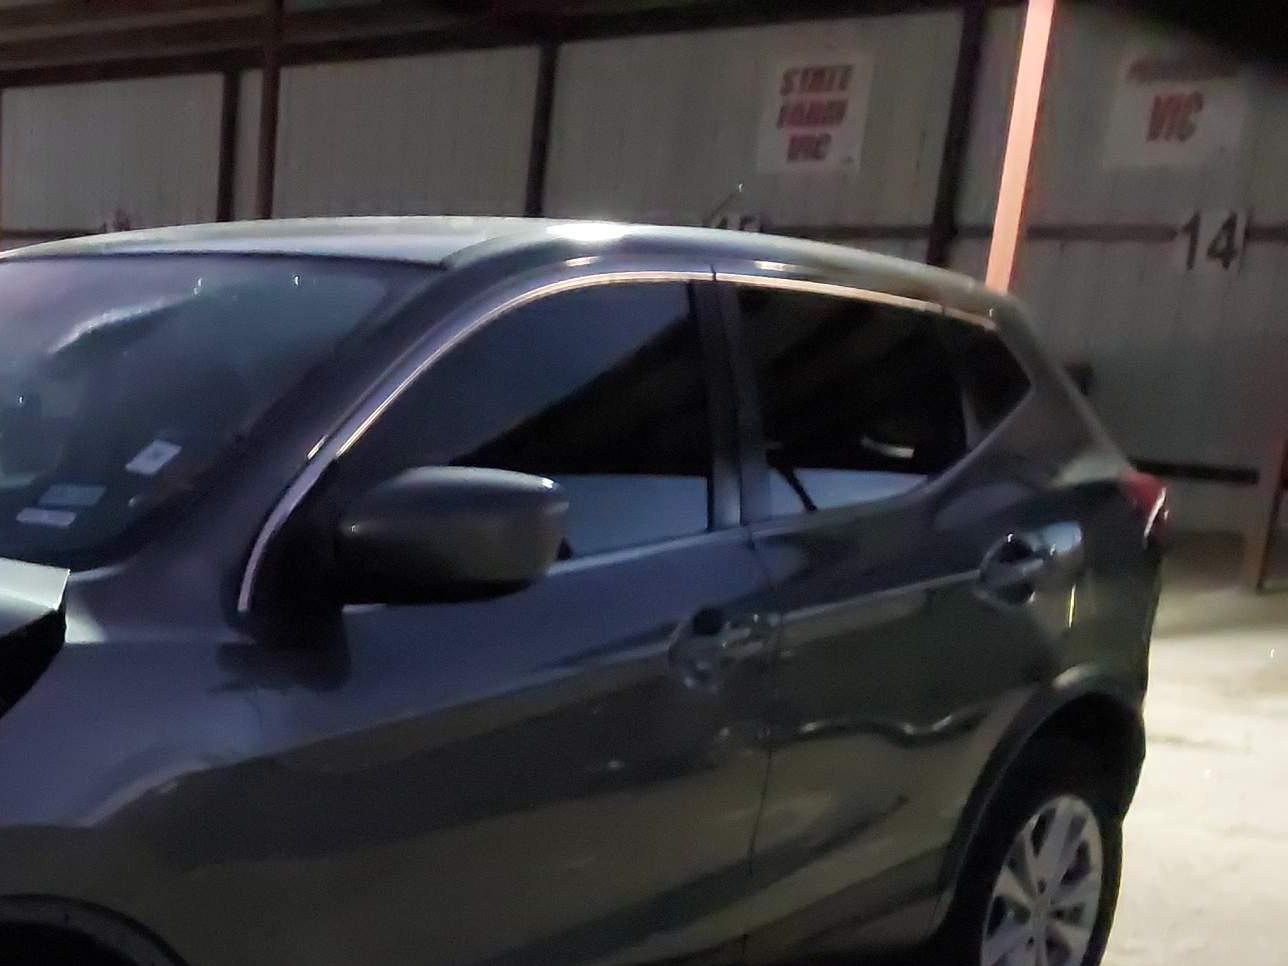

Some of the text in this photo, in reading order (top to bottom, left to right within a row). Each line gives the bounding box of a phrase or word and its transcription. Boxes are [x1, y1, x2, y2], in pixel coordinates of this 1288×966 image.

[779, 64, 854, 96] STATE
[1145, 91, 1204, 143] VIC
[1177, 208, 1240, 271] 14
